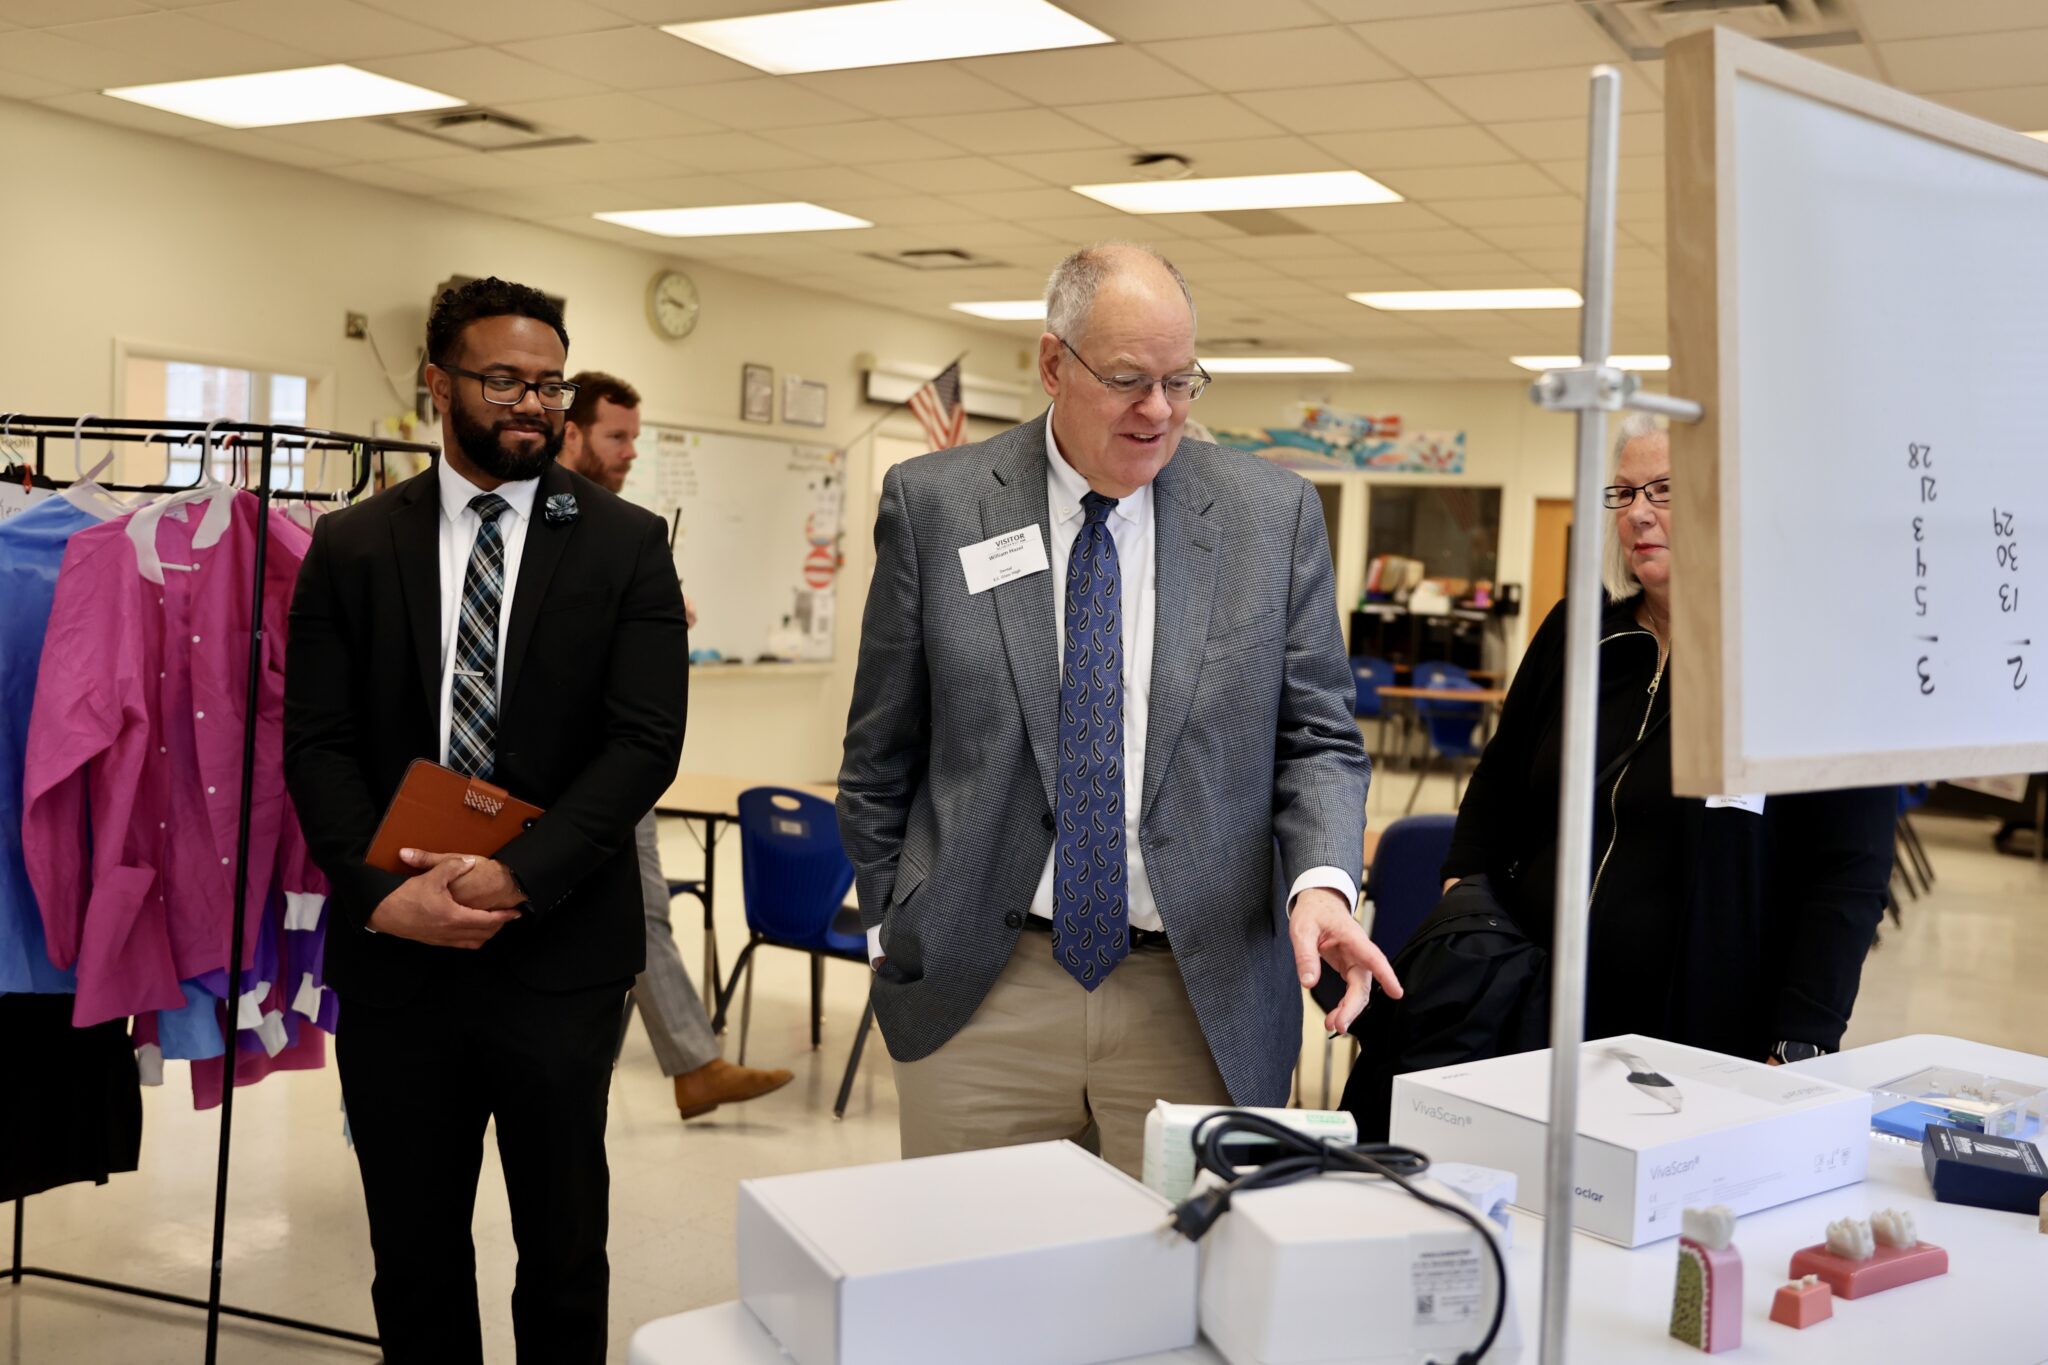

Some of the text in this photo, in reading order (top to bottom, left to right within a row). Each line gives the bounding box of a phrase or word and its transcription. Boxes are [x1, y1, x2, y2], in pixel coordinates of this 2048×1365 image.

[1908, 442, 1932, 469] 28
[1921, 475, 1937, 503] 21
[1912, 517, 1924, 542] 3
[1992, 507, 2014, 537] 29
[995, 533, 1025, 547] VISITOR
[1916, 547, 1927, 578] 4
[1996, 542, 2018, 571] 30
[1915, 586, 1927, 616] 5
[1999, 583, 2018, 612] 13
[1916, 656, 1935, 695] 3
[2007, 655, 2028, 690] 2
[1573, 1187, 1604, 1202] oclar
